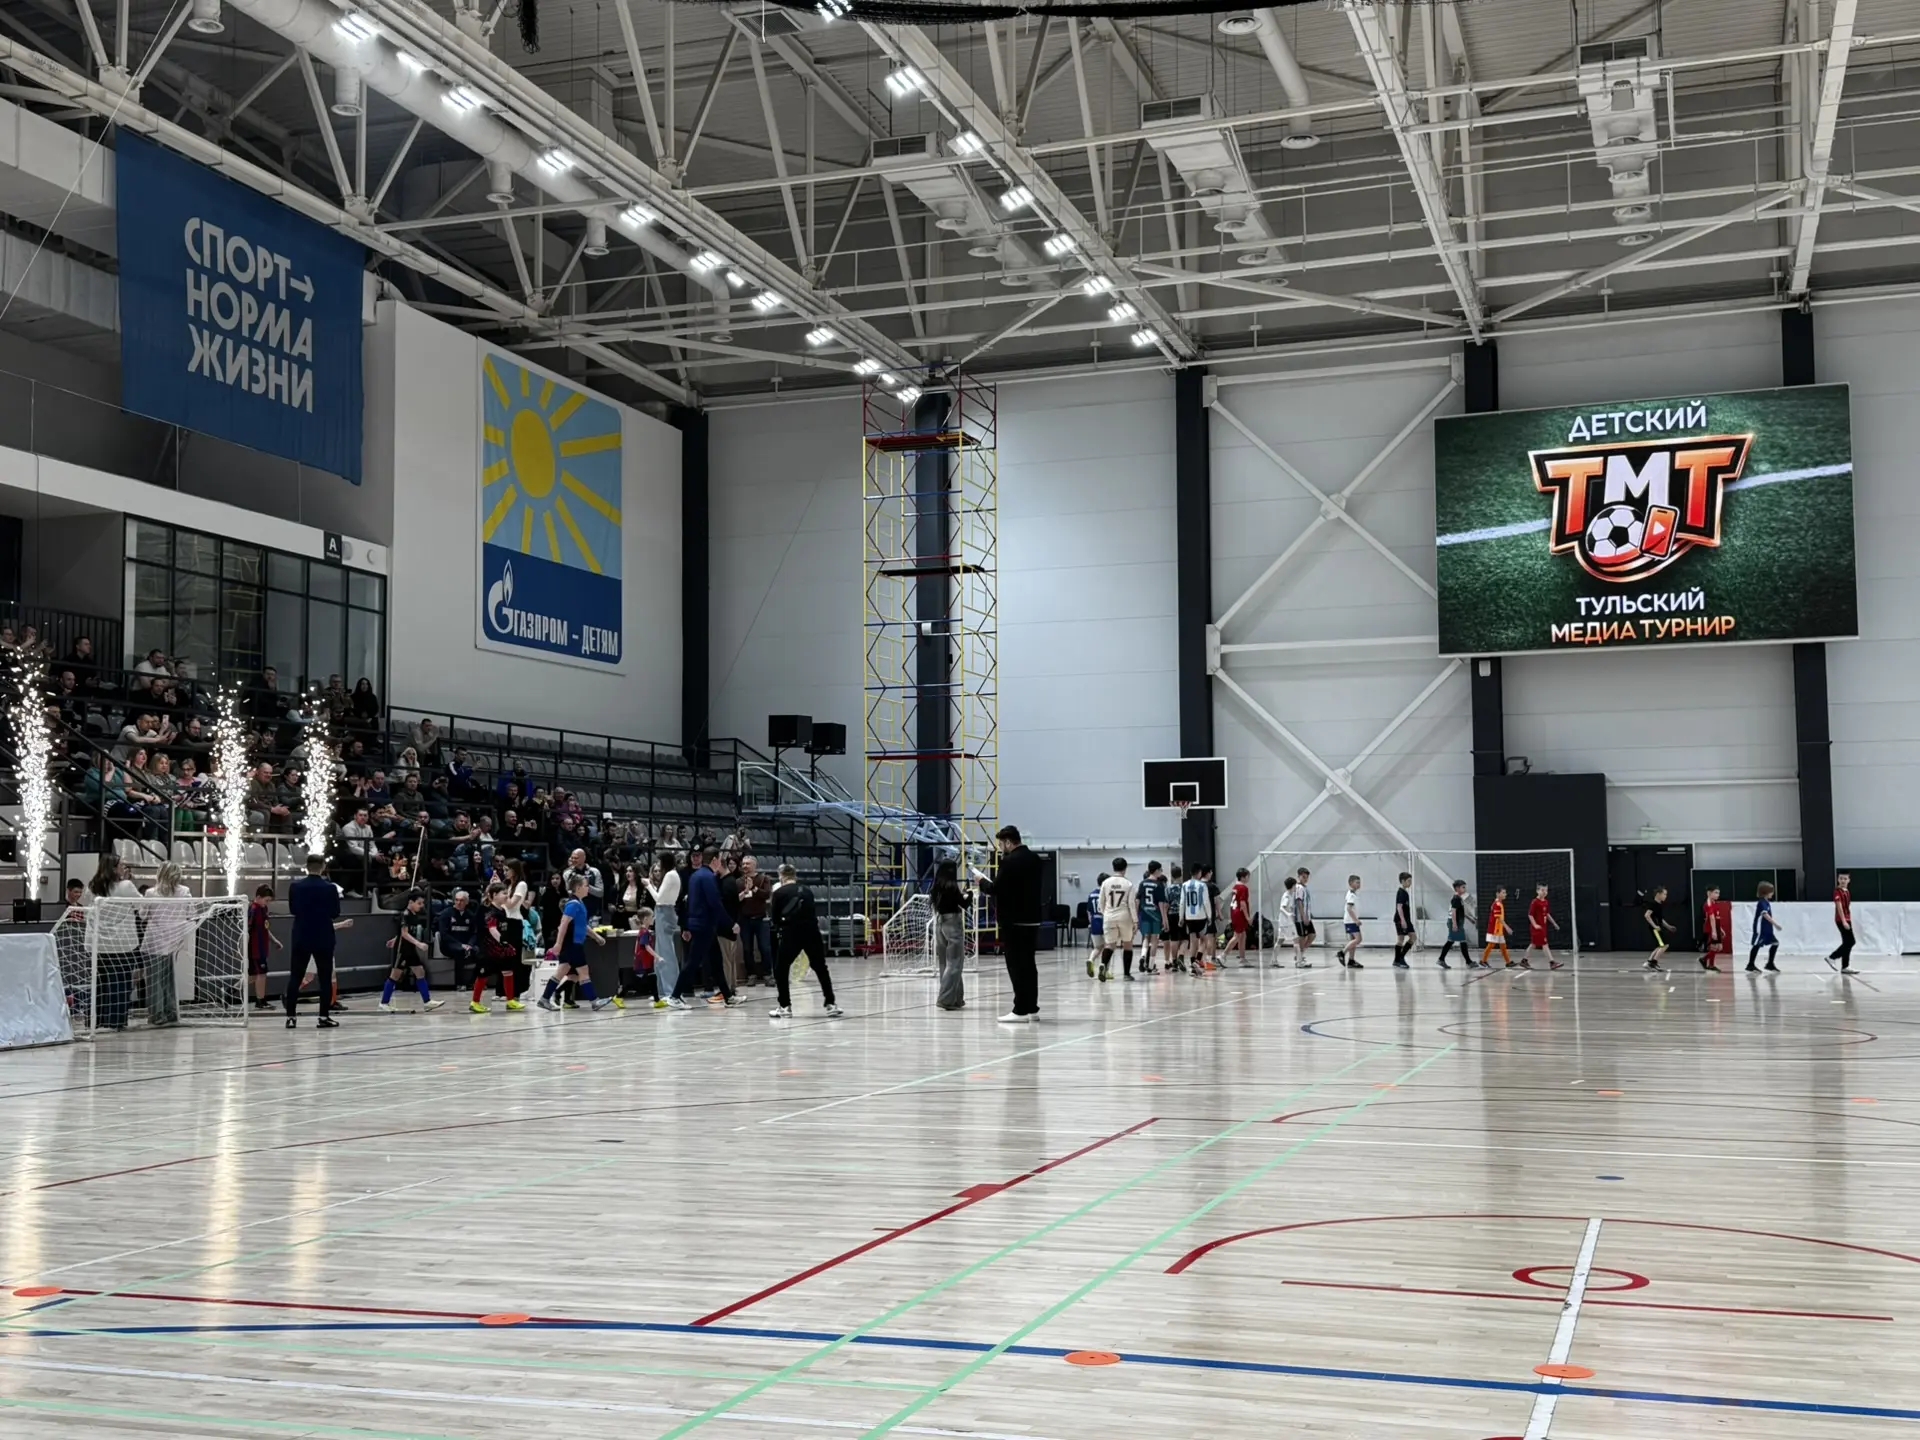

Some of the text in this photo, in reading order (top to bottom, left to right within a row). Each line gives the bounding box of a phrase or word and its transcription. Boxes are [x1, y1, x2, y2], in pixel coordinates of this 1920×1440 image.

[184, 217, 291, 300] СПОРТ
[186, 268, 313, 362] НОРМА
[187, 324, 313, 413] ЖИЗНИ
[1568, 400, 1707, 442] ДЕТСКИЙ
[1544, 446, 1736, 535] ТМТ
[1576, 586, 1705, 616] ТУЛЬСКИЙ
[513, 609, 568, 646] ГАЗПРОМ
[581, 624, 618, 656] ДЕТЯМ
[1551, 615, 1736, 645] МЕДИА ТУРНИР
[1108, 890, 1126, 908] 17
[1145, 887, 1156, 906] 5
[1186, 891, 1198, 907] 10
